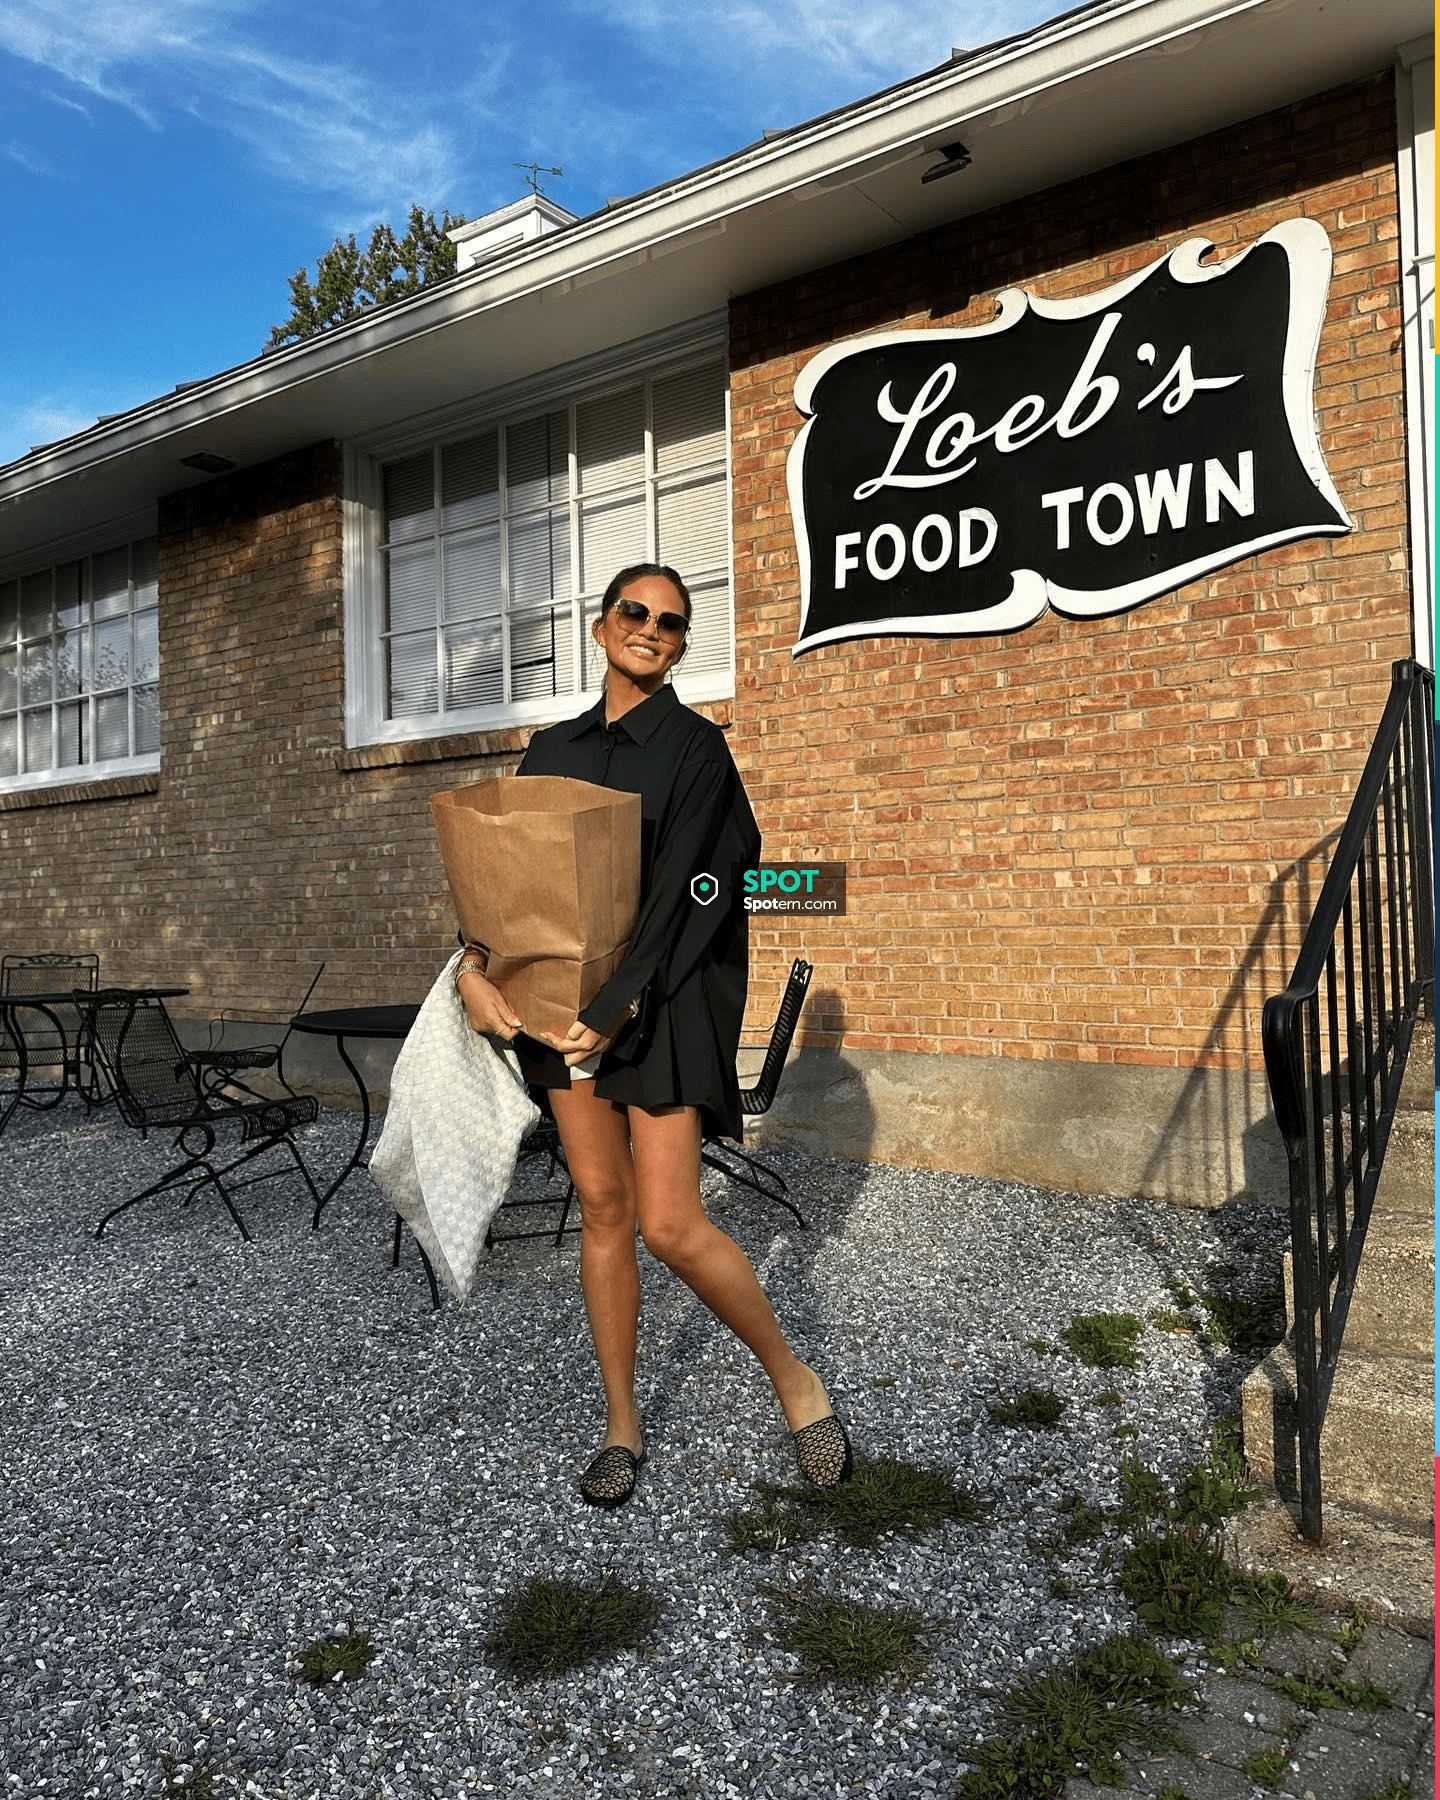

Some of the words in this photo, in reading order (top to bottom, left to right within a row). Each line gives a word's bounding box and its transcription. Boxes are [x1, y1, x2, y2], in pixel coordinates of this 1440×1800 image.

[853, 312, 1245, 501] Loeb's
[834, 506, 998, 590] FOOD
[1041, 450, 1255, 551] TOWN
